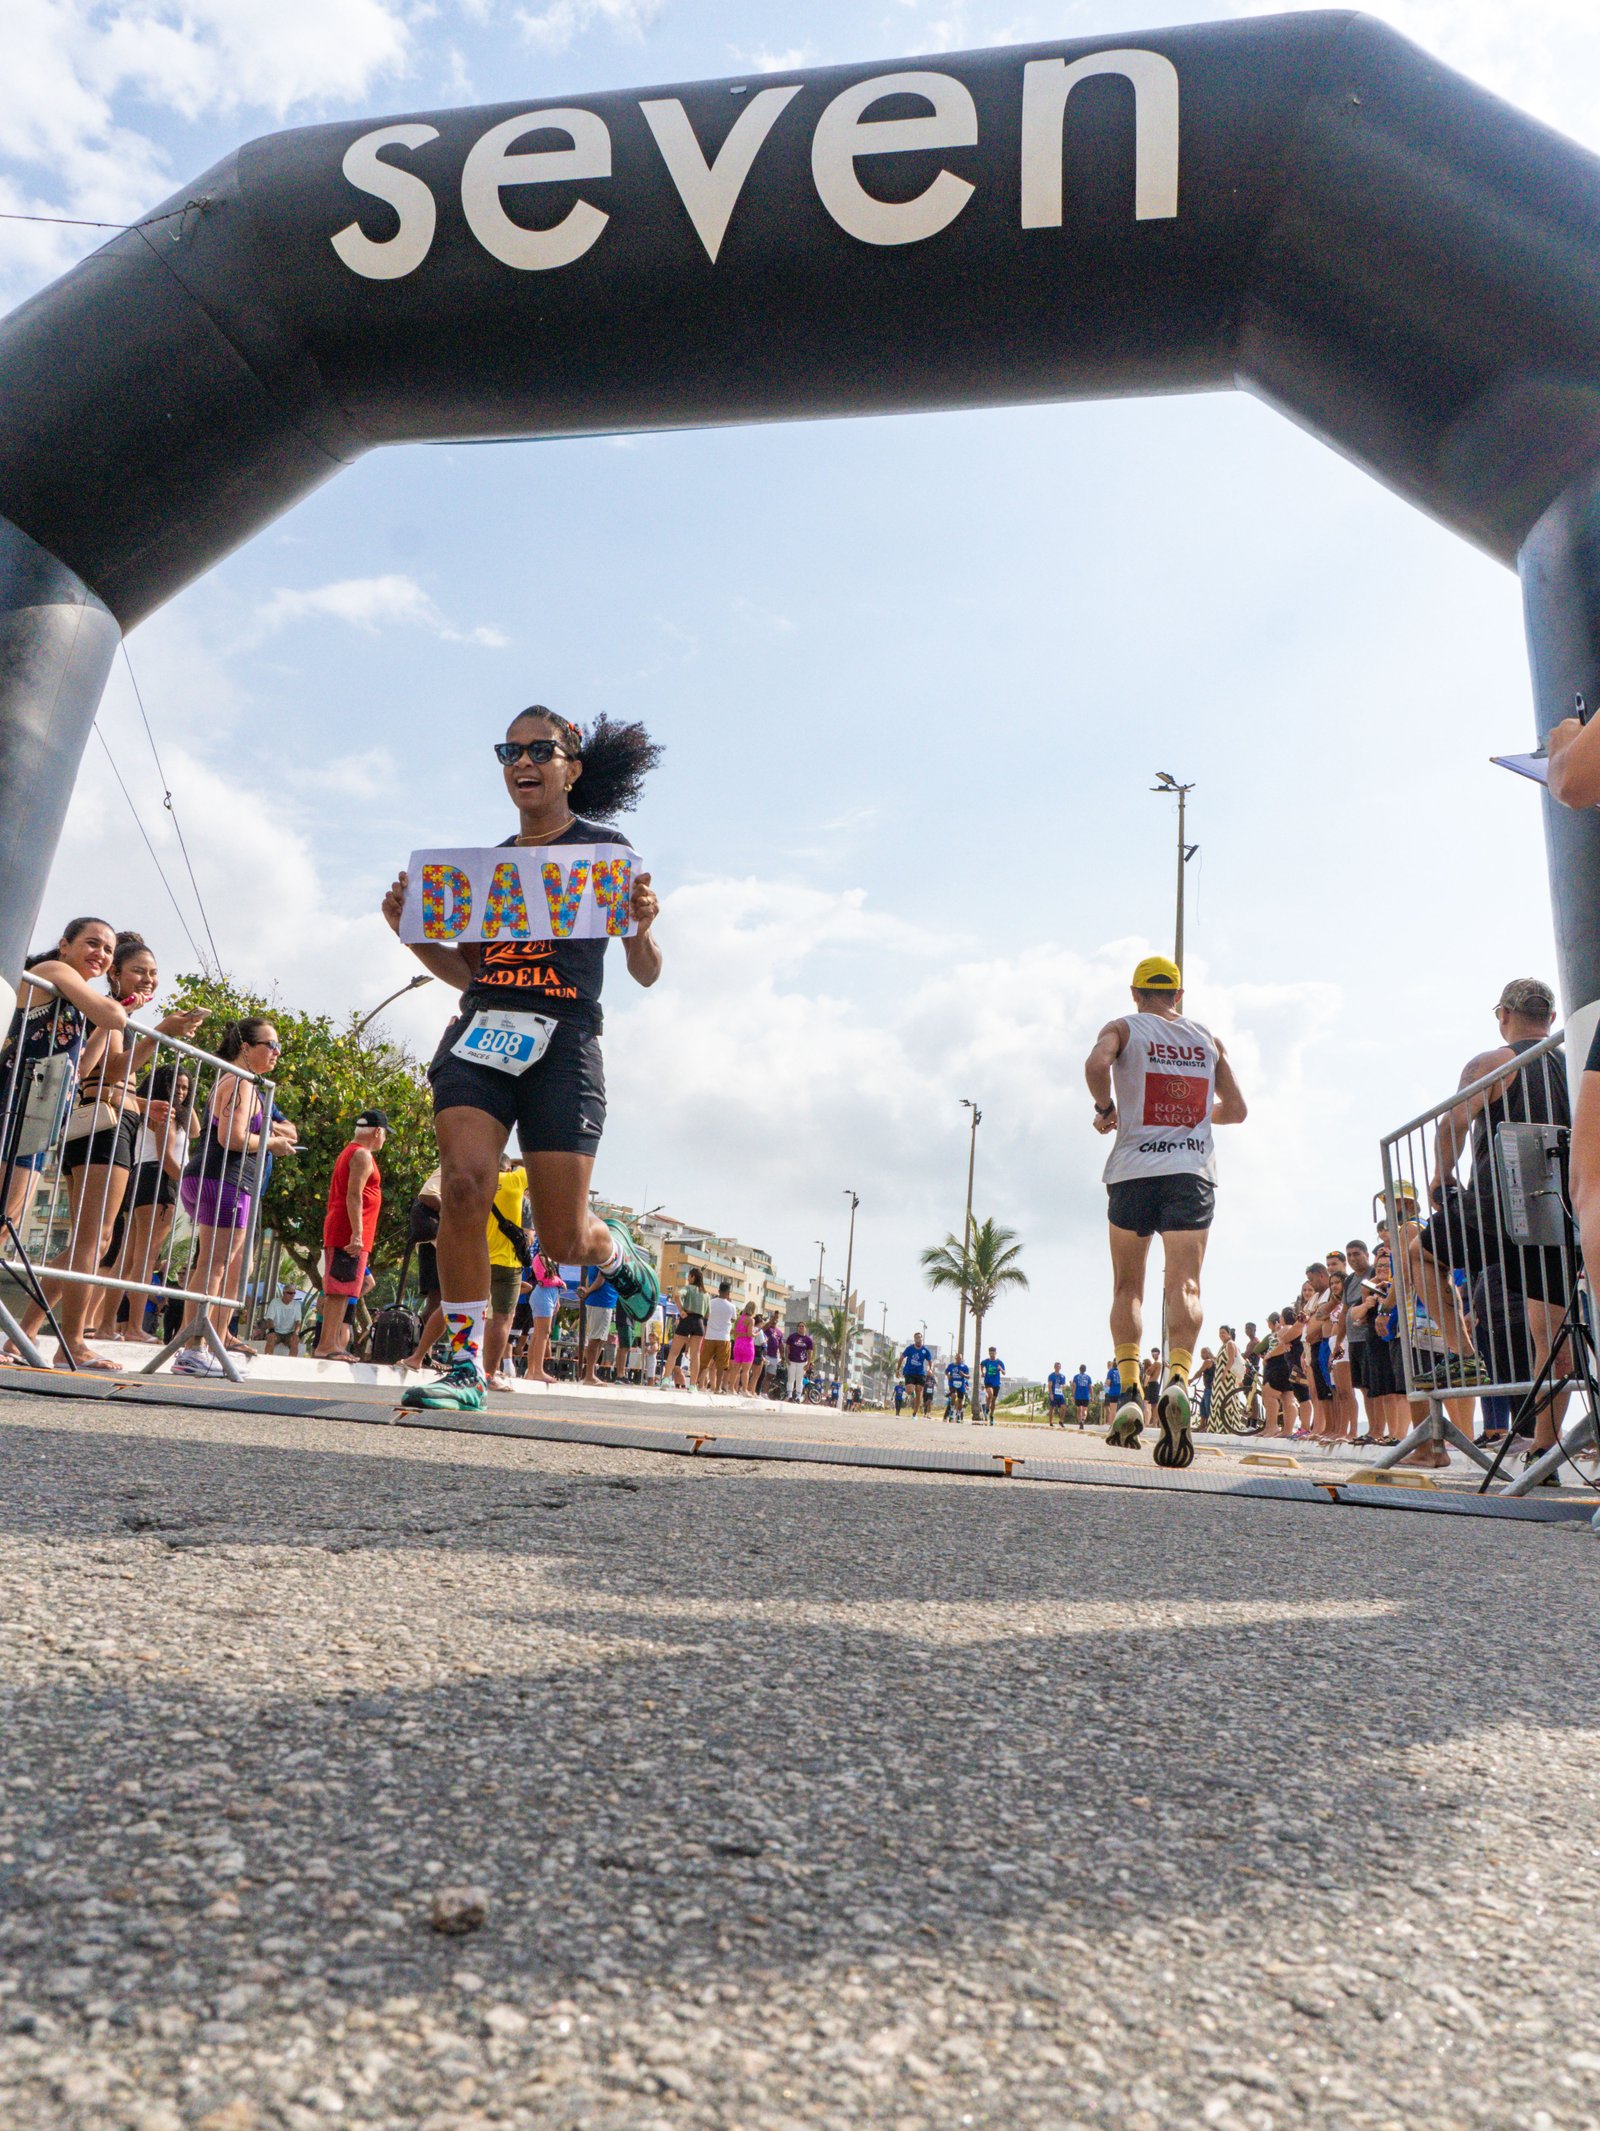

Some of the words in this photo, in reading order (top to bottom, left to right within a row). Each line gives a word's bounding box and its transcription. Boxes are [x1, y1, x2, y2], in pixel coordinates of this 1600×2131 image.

[330, 48, 1179, 280] seven
[545, 987, 577, 999] RUN
[477, 1029, 523, 1056] 808
[467, 1051, 486, 1059] PACE
[1147, 1040, 1206, 1061] JESUS
[1149, 1056, 1206, 1068] MARATONISTA
[1154, 1103, 1192, 1114] ROSA
